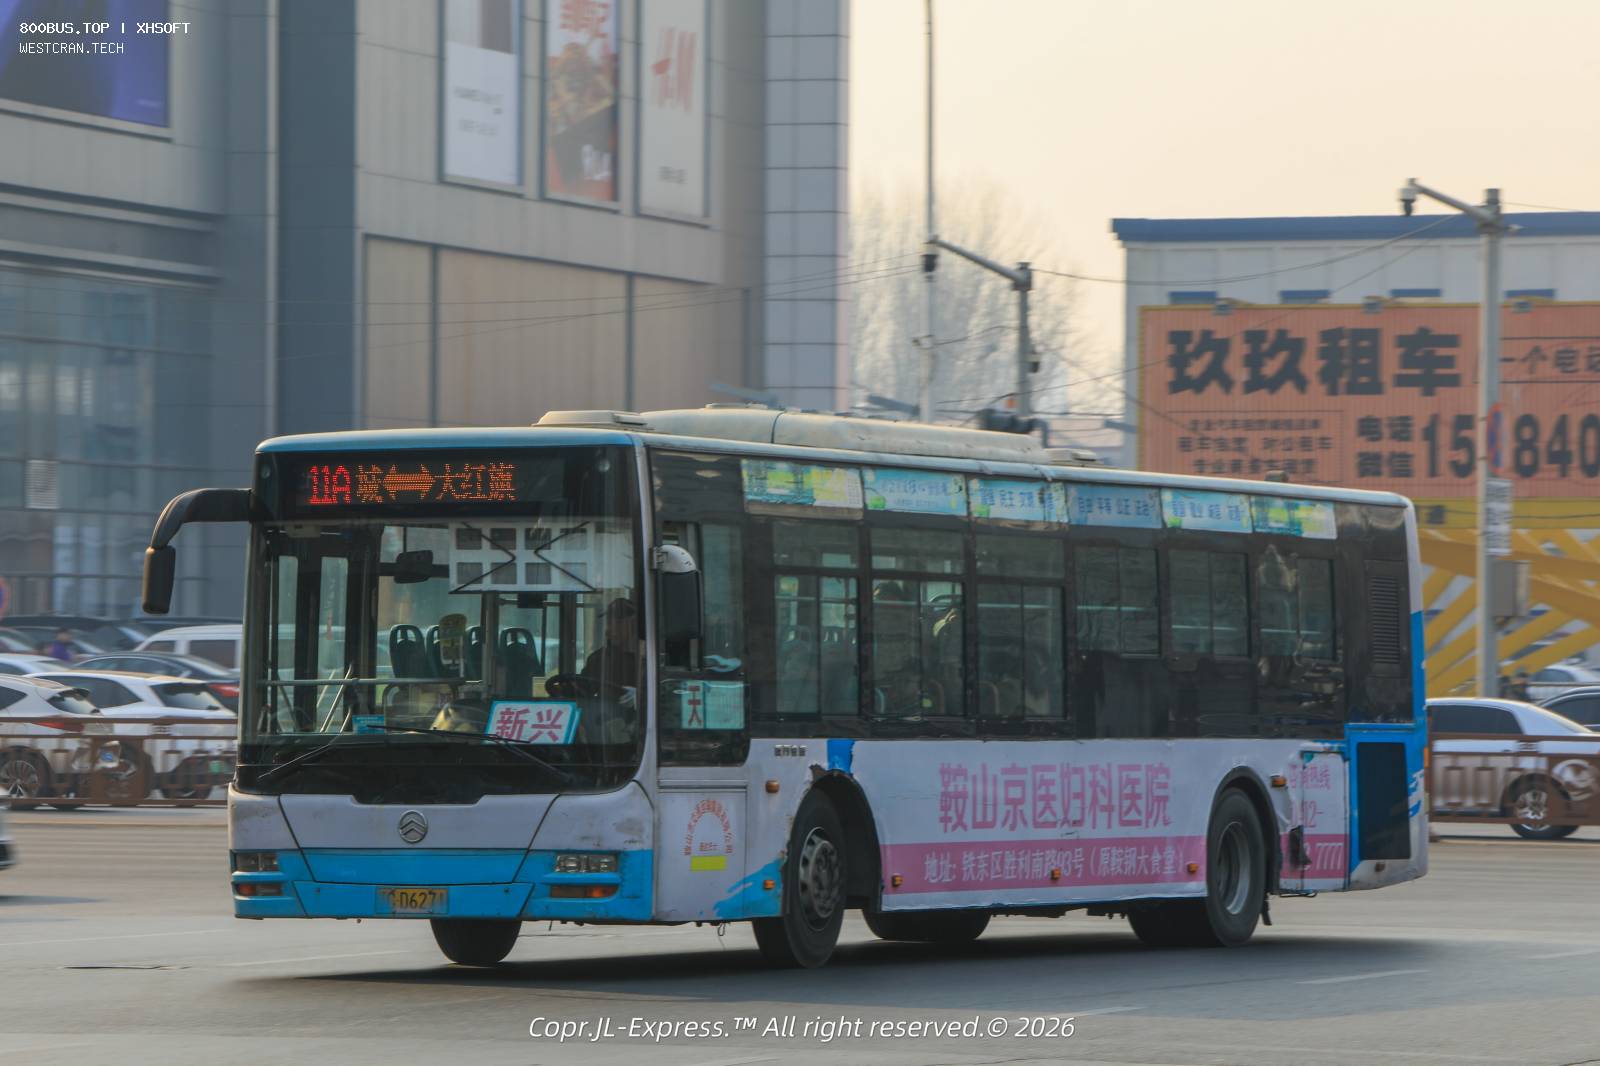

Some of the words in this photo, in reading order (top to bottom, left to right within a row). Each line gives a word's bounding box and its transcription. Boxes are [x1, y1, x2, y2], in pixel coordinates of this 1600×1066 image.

[1168, 326, 1461, 397] 玖玖租车
[1356, 416, 1413, 442] 电话
[1421, 413, 1600, 479] 15840
[310, 465, 350, 504] 11A
[435, 463, 516, 501] 大红旗
[495, 707, 563, 742] 新兴
[938, 762, 1172, 833] 鞍山京医妇科医院
